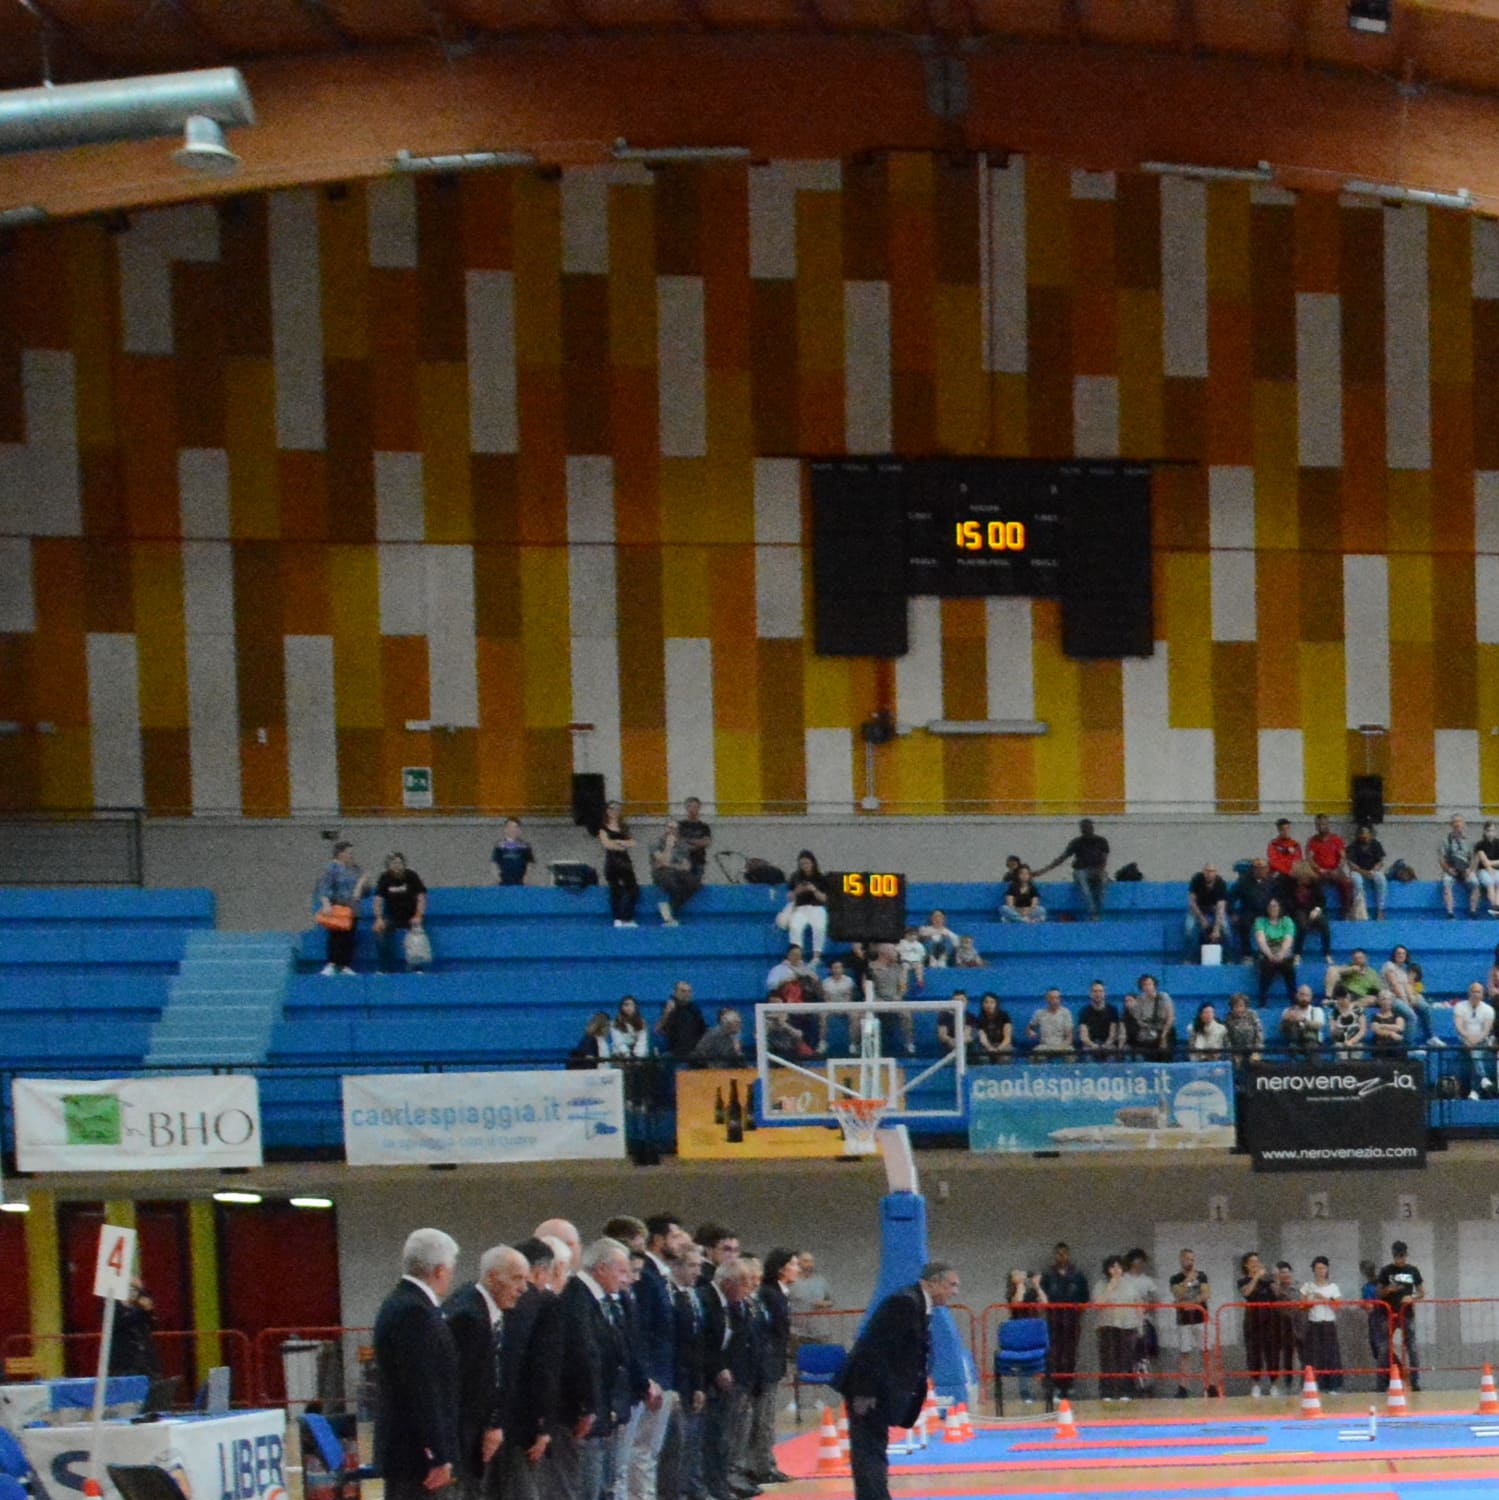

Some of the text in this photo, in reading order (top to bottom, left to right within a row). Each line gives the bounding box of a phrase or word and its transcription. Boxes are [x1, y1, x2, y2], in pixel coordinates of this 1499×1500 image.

[149, 1109, 254, 1147] BHO
[351, 1095, 562, 1132] caorlespiaggia.it
[1262, 1146, 1418, 1160] www.nerovenezia.com
[106, 1236, 125, 1277] 4
